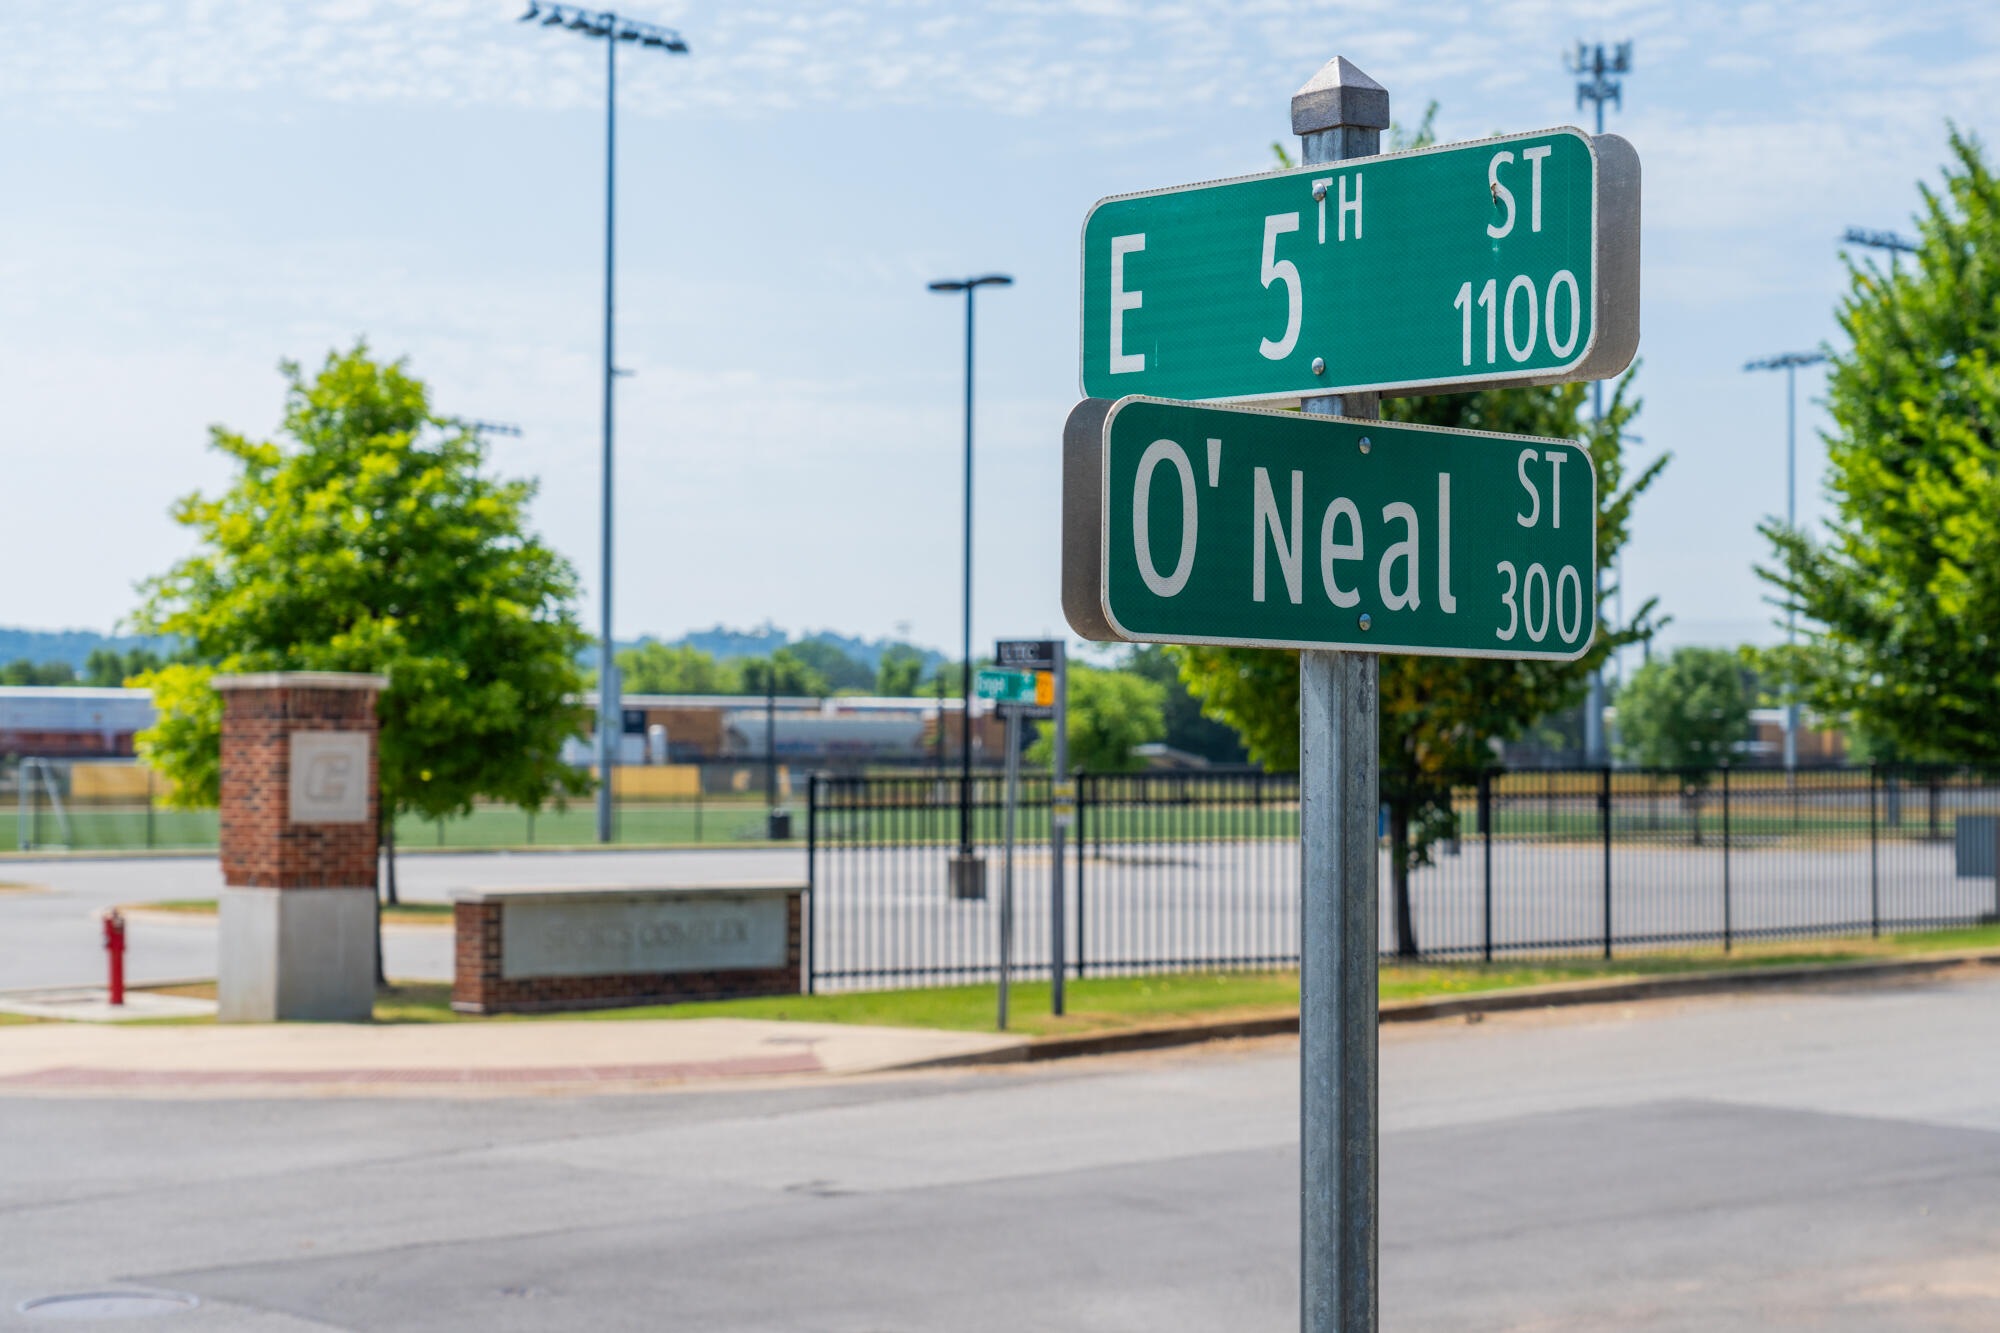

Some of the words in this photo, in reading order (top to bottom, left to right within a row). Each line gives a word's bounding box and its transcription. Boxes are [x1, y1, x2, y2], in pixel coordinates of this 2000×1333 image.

[1109, 232, 1146, 375] E
[1486, 145, 1552, 239] ST
[1453, 269, 1581, 367] 1100
[1132, 438, 1457, 615] O'Neal
[1516, 448, 1568, 529] ST
[1496, 561, 1583, 644] 300
